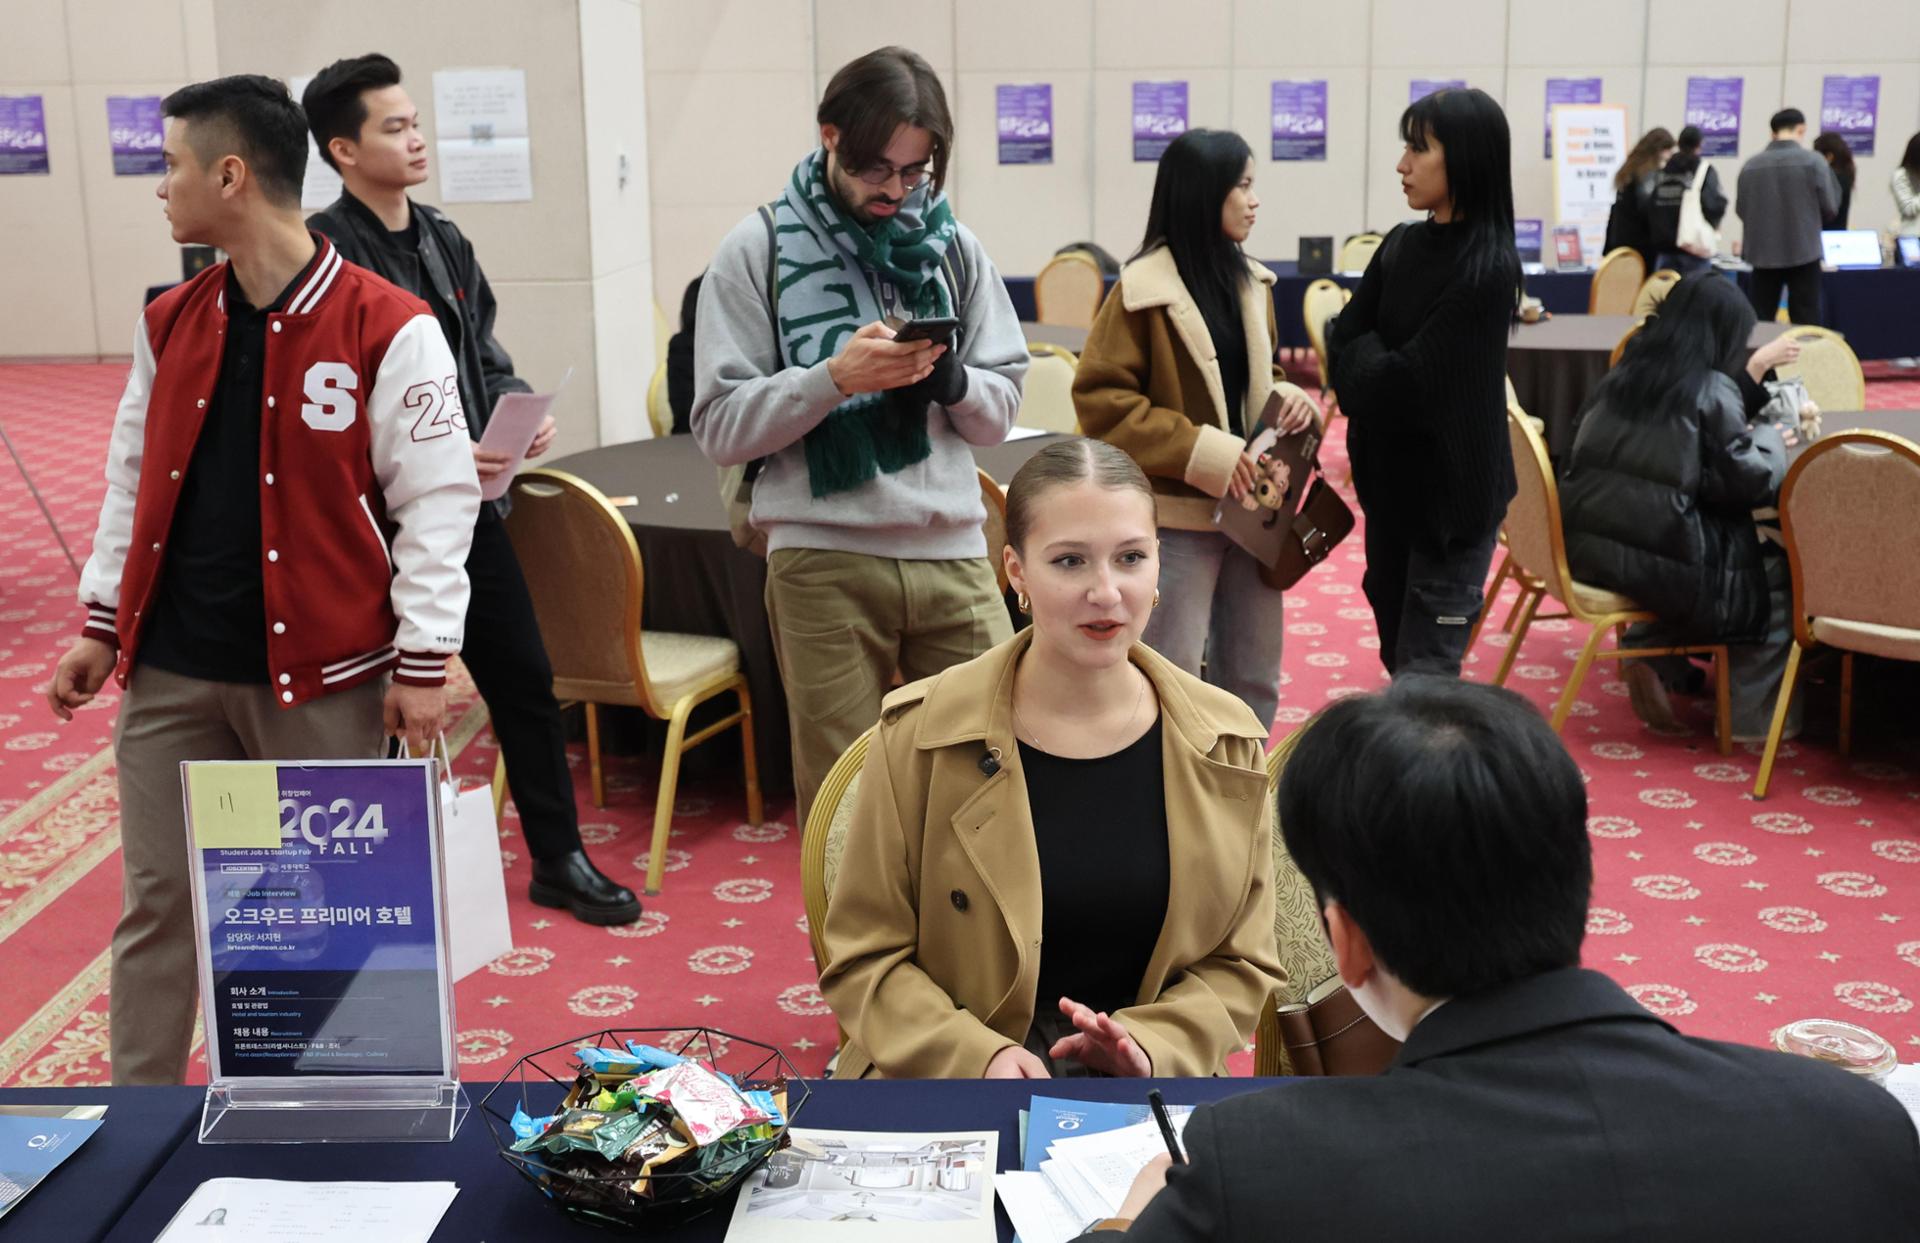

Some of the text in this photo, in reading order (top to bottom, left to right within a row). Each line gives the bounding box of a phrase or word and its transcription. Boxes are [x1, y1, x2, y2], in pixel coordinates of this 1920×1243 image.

[301, 361, 358, 432] S
[403, 375, 468, 442] 23
[279, 798, 389, 845] 2024
[271, 849, 298, 857] Startup
[319, 842, 374, 854] FALL
[225, 906, 412, 926] 오크우드 프리미어 호텔
[226, 933, 254, 942] 담당자:
[230, 986, 247, 997] 회사
[249, 986, 266, 996] 소개
[233, 1027, 250, 1037] 채용
[252, 1027, 269, 1037] 내용
